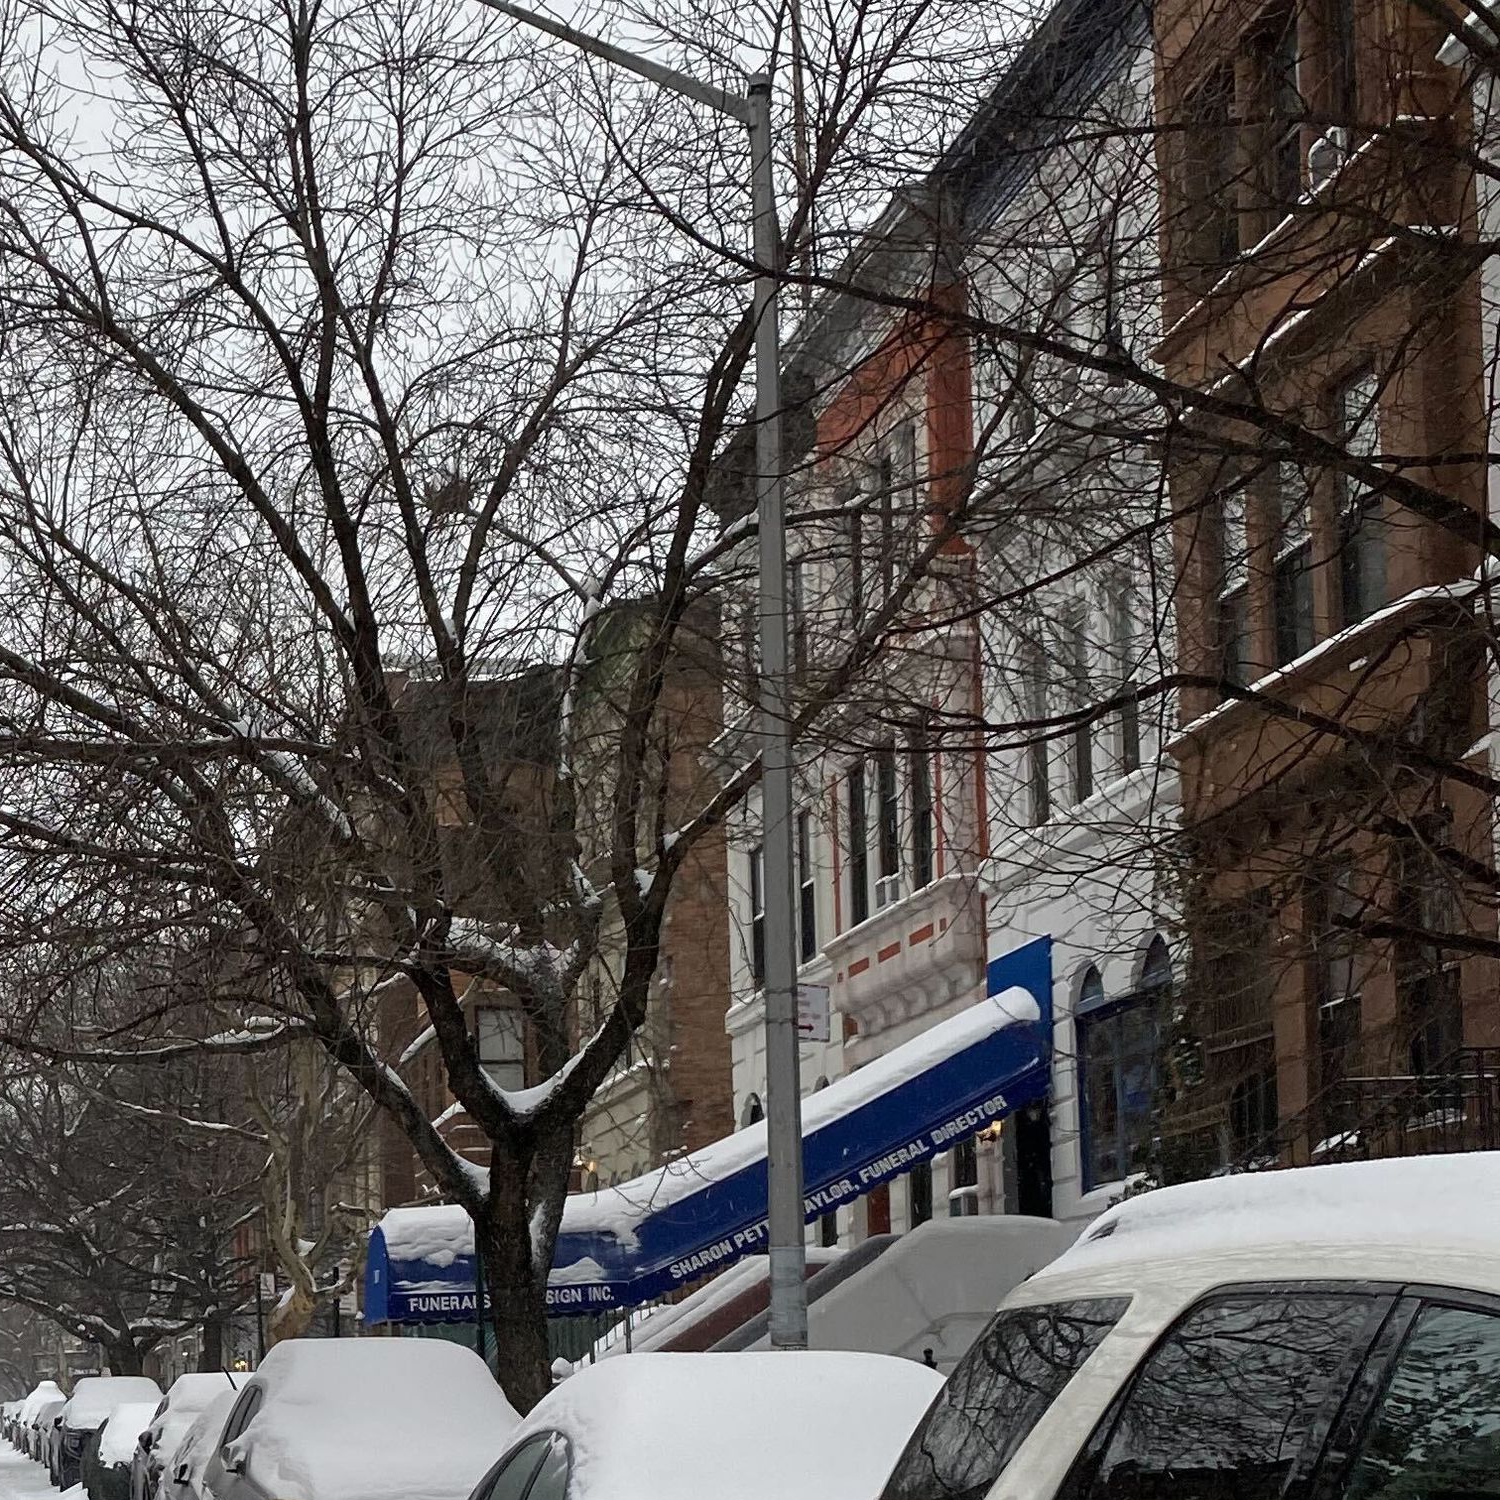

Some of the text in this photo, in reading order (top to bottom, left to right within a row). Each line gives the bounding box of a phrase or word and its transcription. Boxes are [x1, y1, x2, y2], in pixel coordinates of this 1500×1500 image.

[669, 1094, 1008, 1280] SHARON PETT AYLOR, FUNERAL DIRECTOR
[545, 1286, 582, 1305] SIGN
[588, 1286, 615, 1302] INC.
